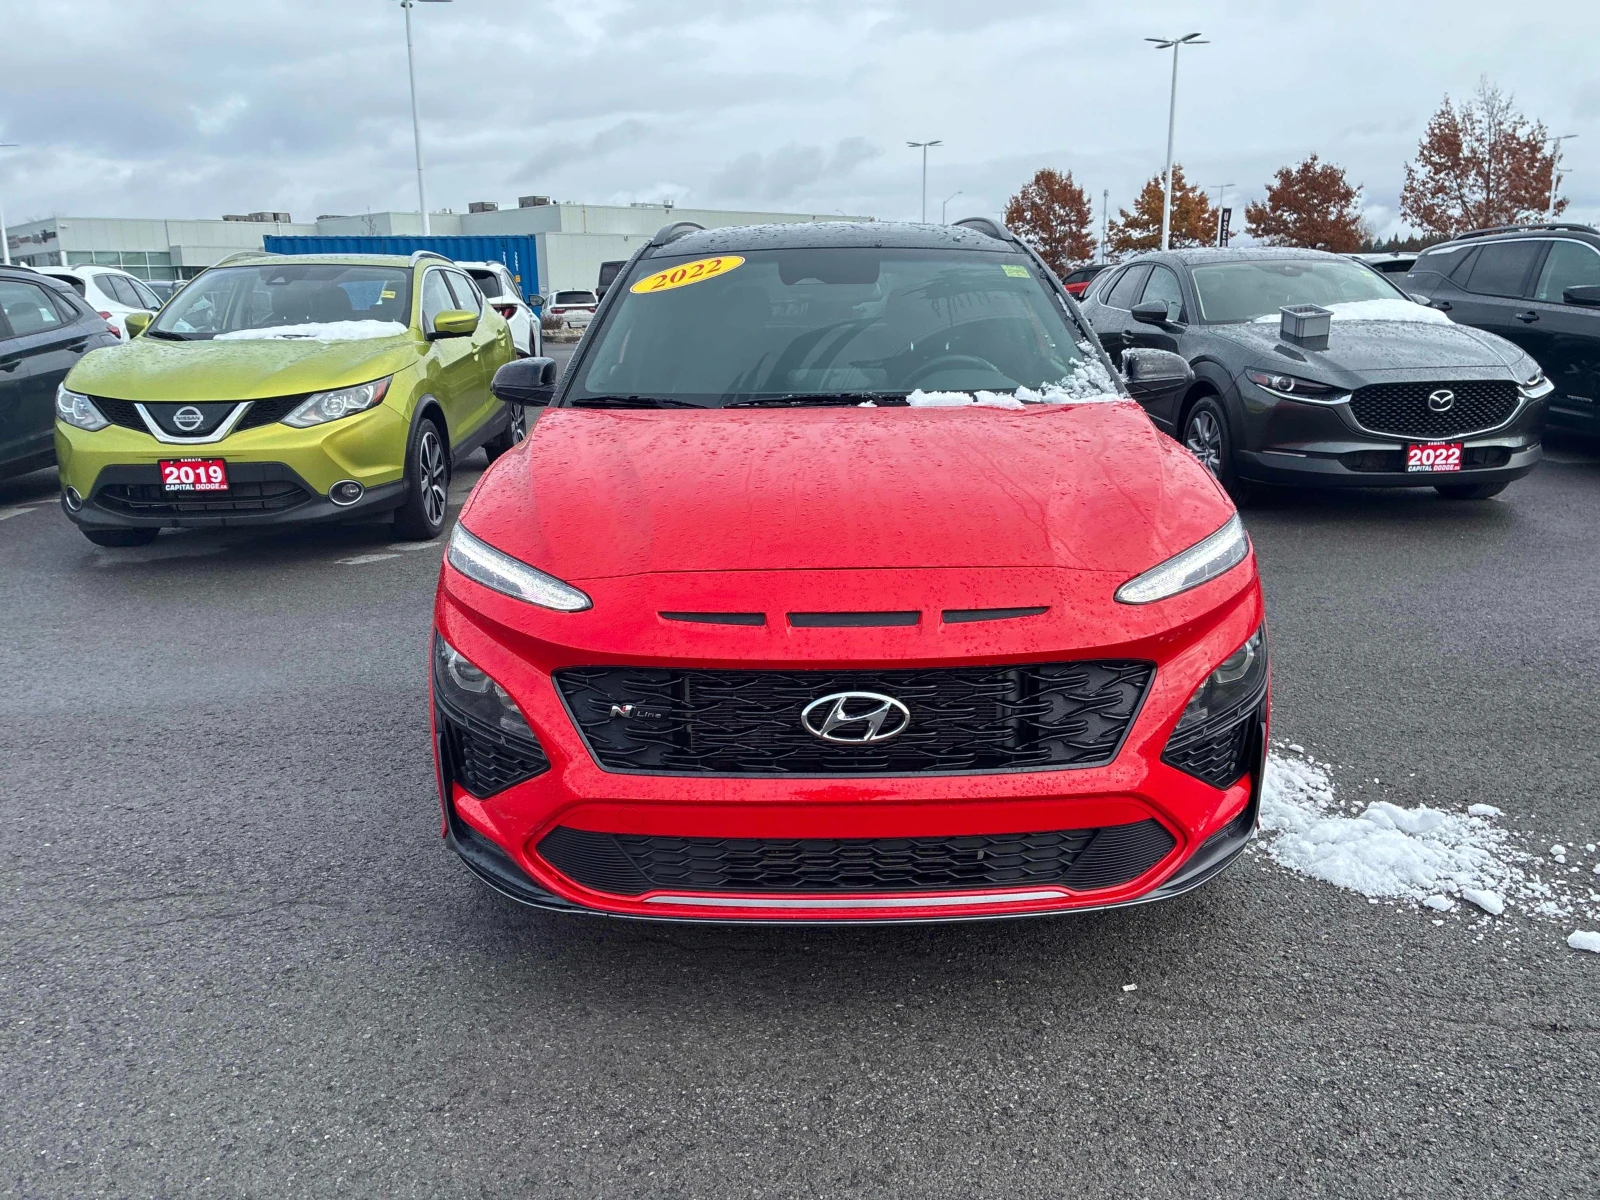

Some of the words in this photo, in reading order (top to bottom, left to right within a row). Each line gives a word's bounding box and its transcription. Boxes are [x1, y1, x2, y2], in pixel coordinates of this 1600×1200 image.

[651, 259, 722, 290] 2022
[1408, 447, 1460, 466] 2022
[164, 465, 223, 484] 2019
